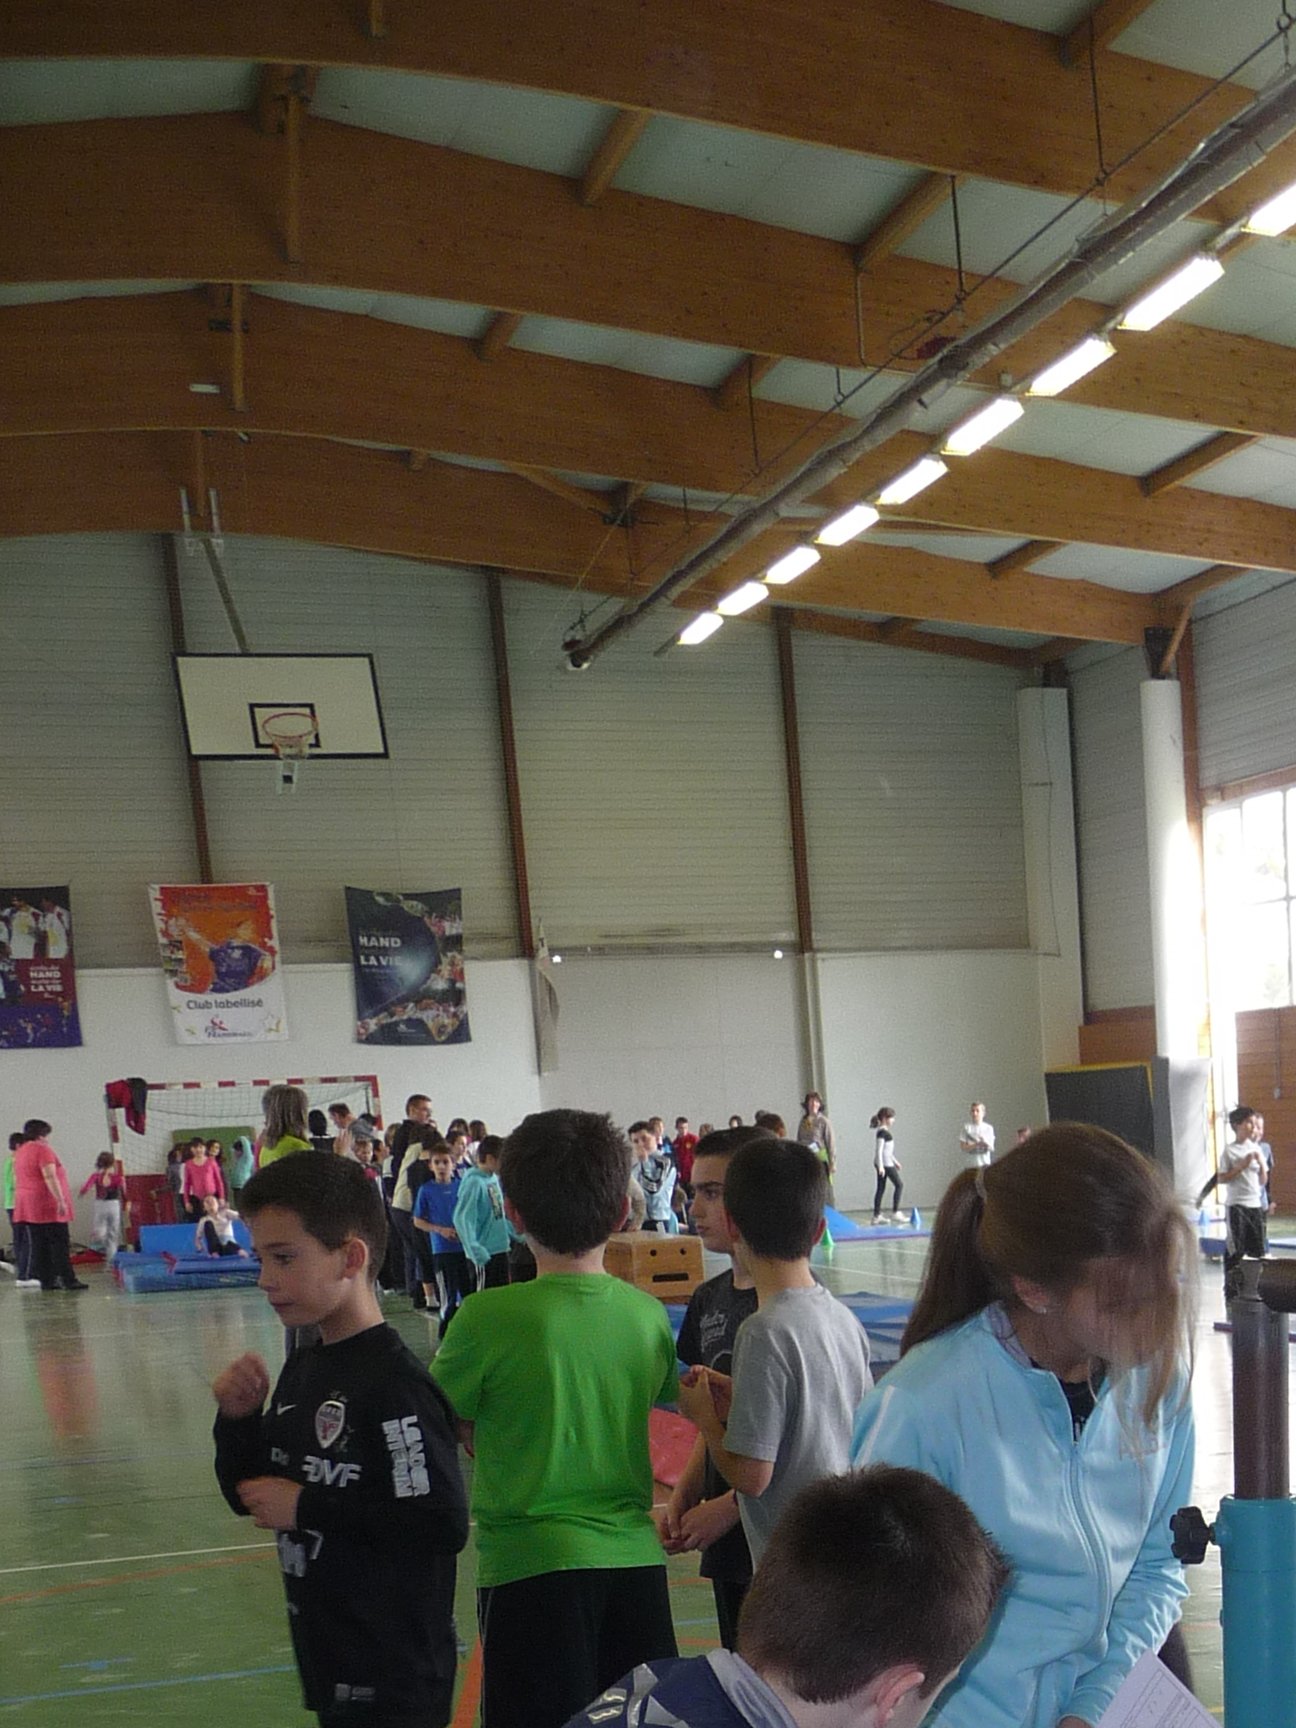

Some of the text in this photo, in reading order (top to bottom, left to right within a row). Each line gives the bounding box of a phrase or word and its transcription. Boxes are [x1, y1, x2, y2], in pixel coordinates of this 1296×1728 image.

[358, 935, 402, 949] HAND
[360, 955, 380, 967] LA
[29, 970, 62, 979] HAND
[186, 997, 264, 1010] Club labellisé
